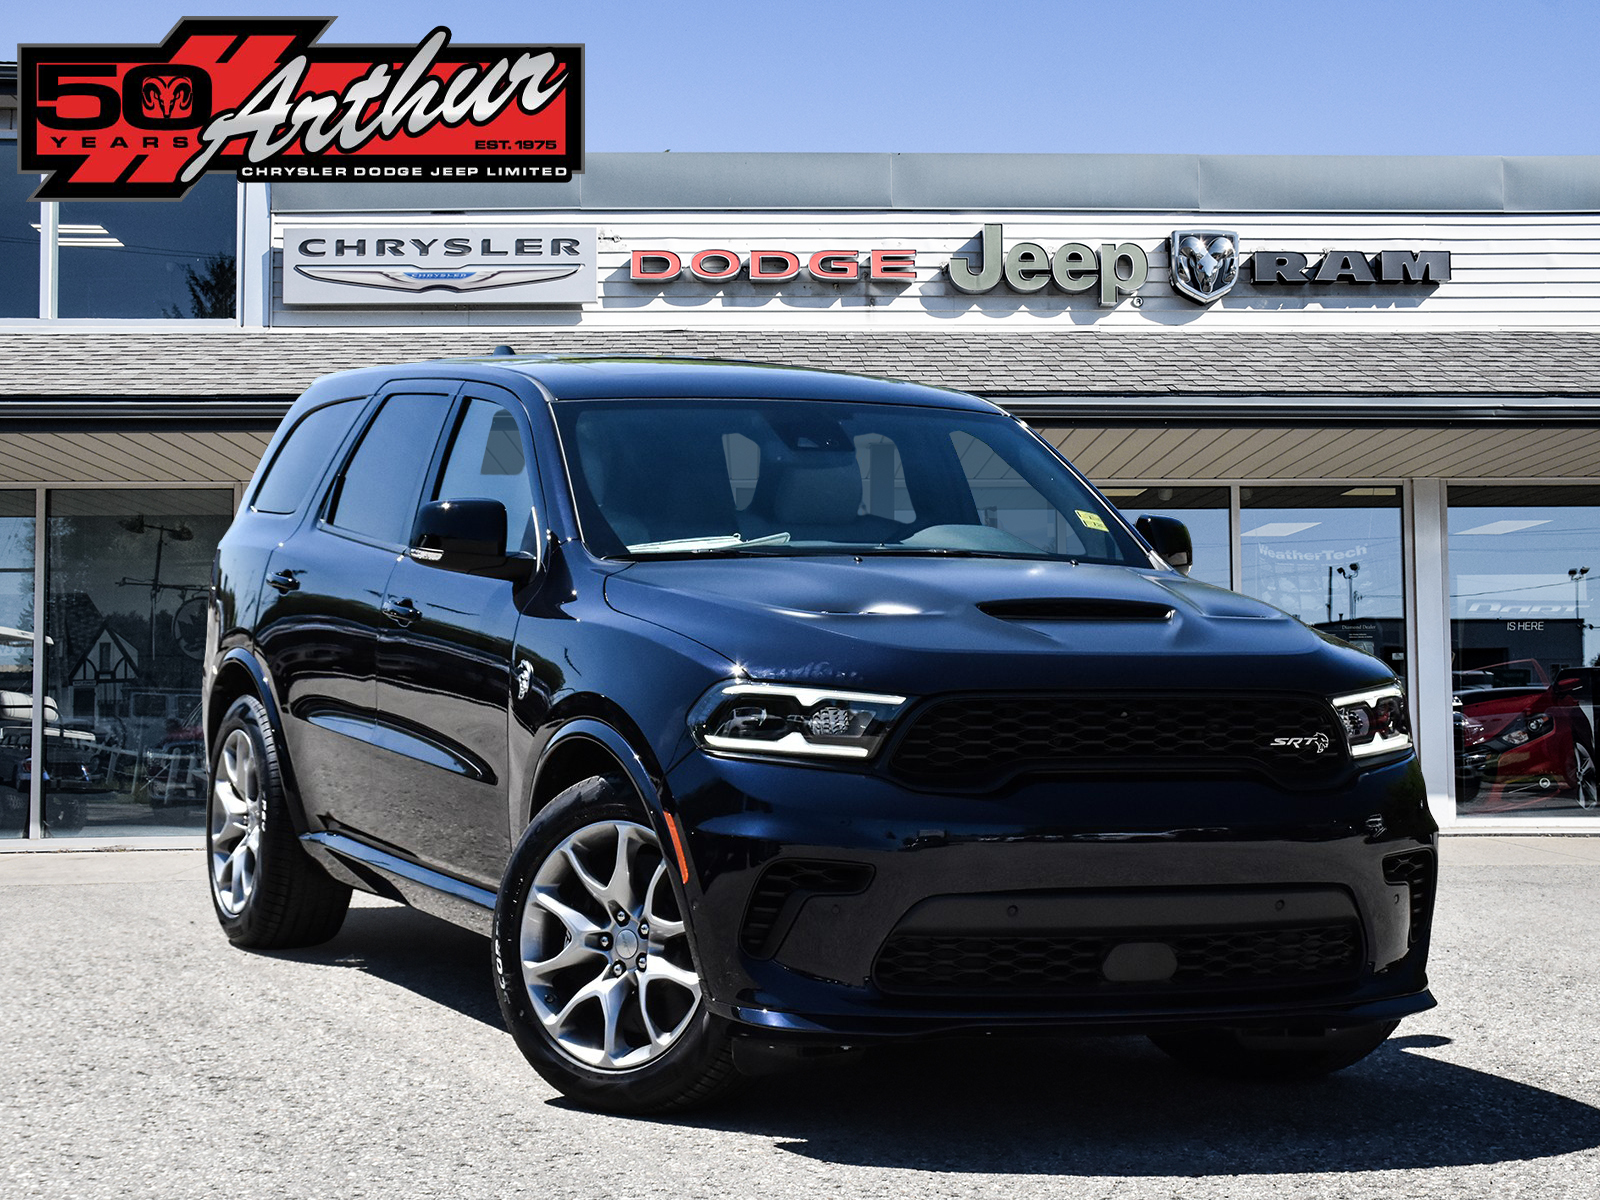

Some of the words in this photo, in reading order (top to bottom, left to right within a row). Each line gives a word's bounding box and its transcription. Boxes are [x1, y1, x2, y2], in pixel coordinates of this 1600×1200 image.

[299, 238, 581, 258] CHRYSLER
[630, 248, 918, 284] DODGE
[948, 223, 1149, 307] Jeep
[1250, 250, 1452, 285] RAM
[1506, 621, 1516, 631] IS
[1517, 621, 1545, 631] HERE
[1270, 737, 1318, 749] SRT
